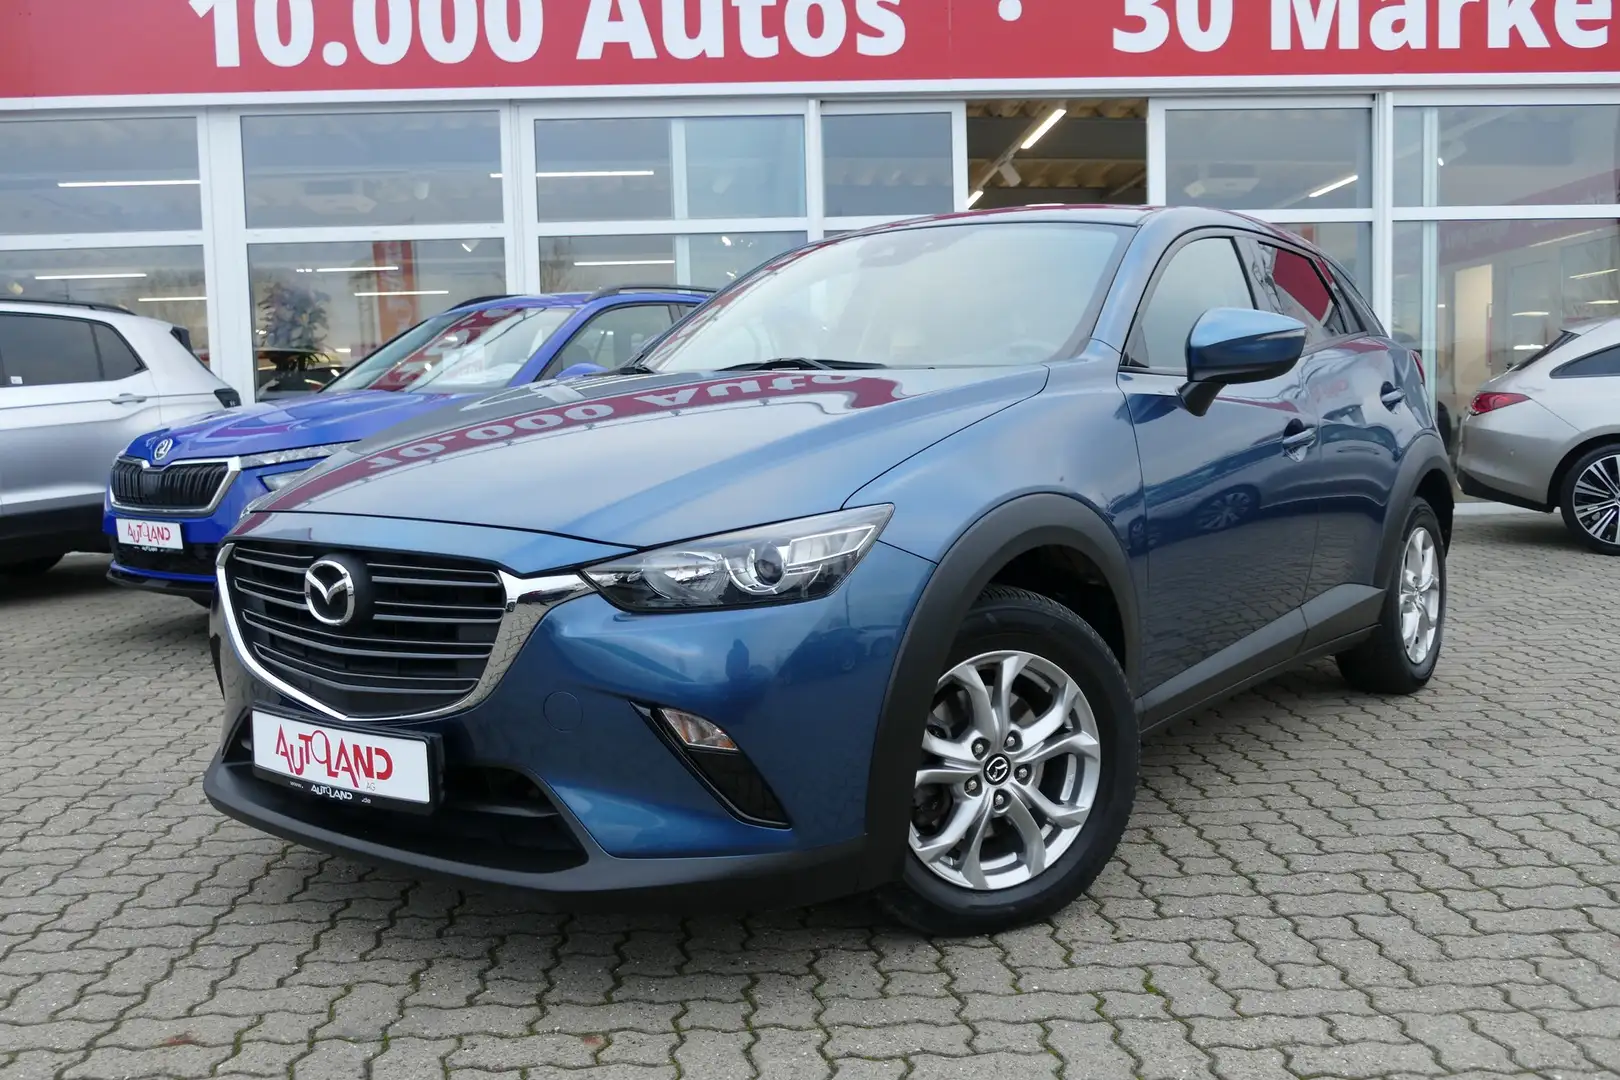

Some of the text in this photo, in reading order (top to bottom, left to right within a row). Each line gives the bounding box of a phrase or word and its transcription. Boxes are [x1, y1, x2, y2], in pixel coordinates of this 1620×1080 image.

[188, 0, 1612, 67] 10.000 Autos 30 Marke
[127, 522, 171, 545] AUTOLAND
[275, 724, 393, 788] AUTOLAND
[311, 784, 352, 800] AUTOLAND
[366, 782, 376, 792] AG
